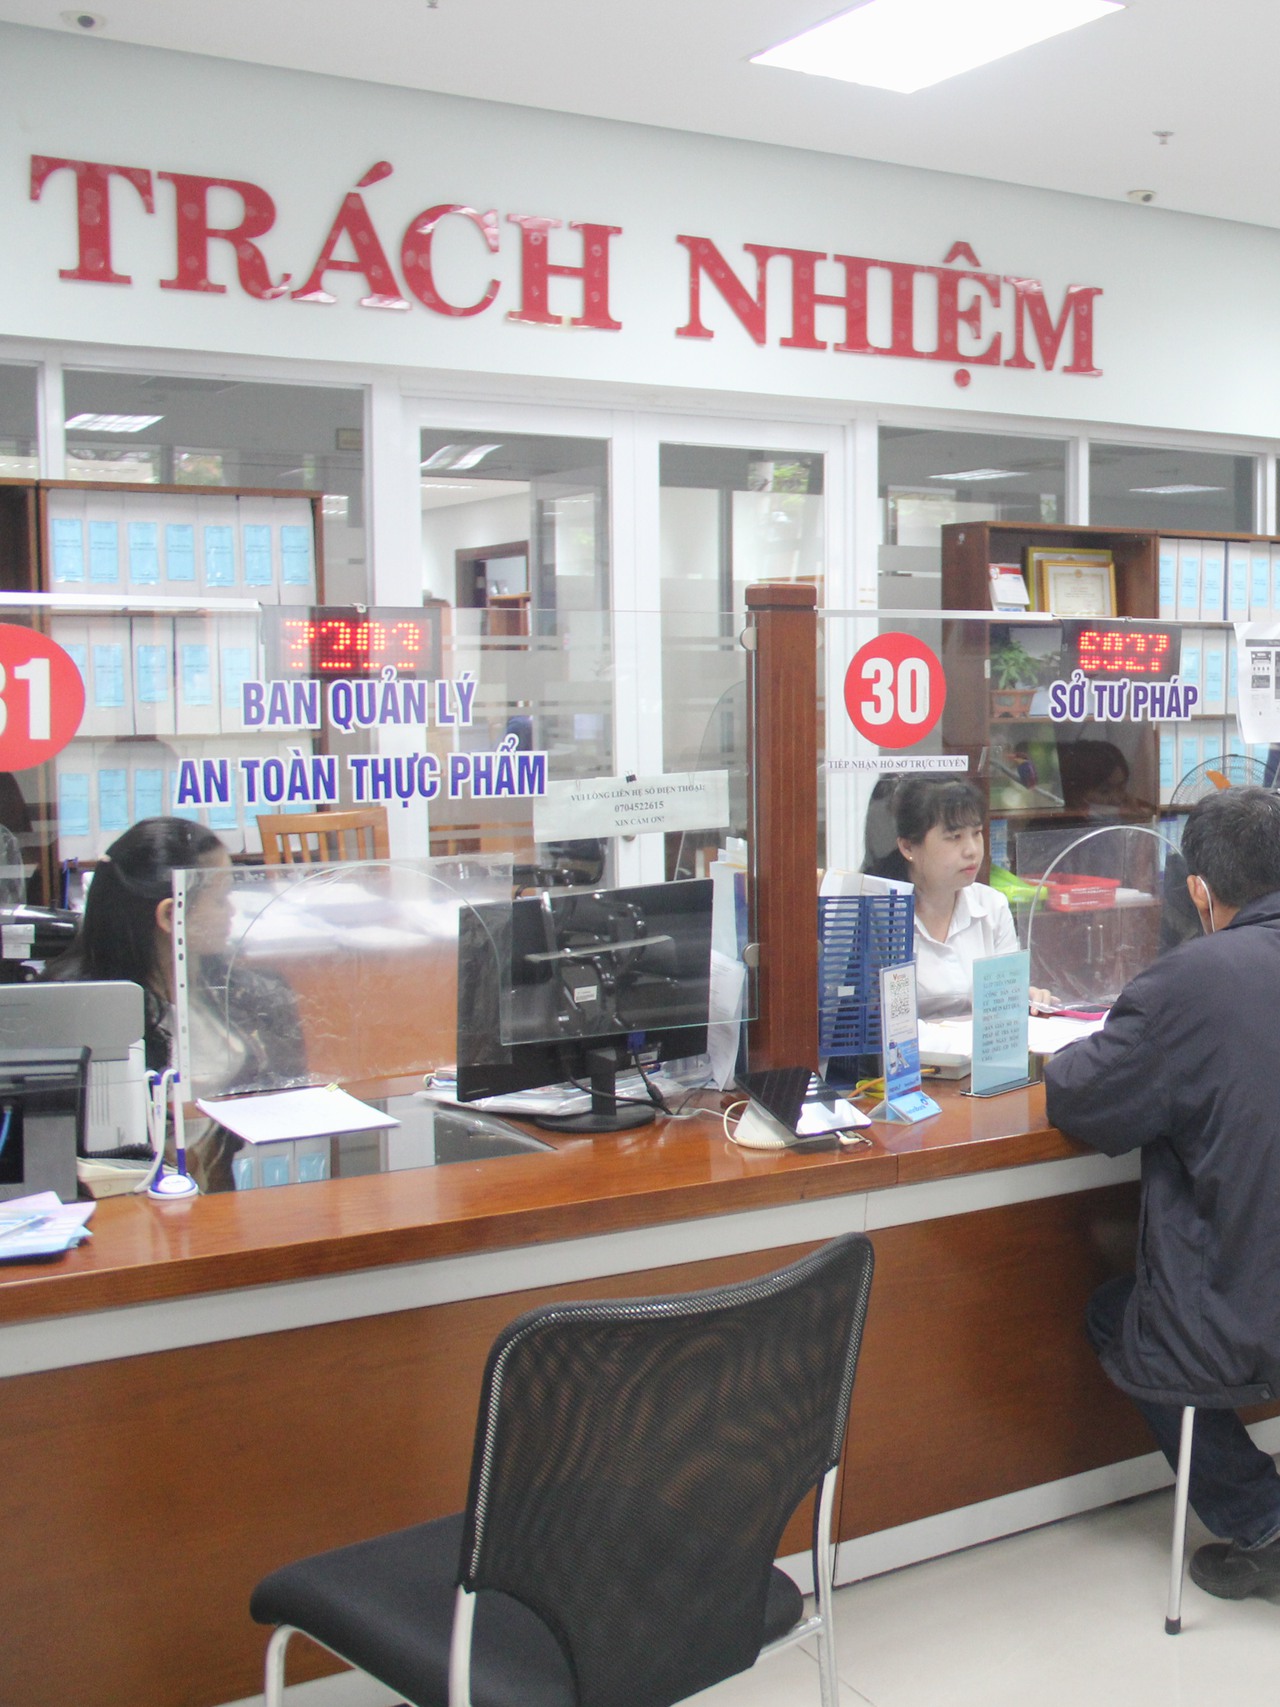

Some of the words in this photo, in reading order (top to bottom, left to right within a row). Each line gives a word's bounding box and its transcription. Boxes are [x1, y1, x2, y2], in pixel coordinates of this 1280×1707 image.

[30, 154, 623, 331] TRÁCH
[676, 234, 1104, 388] NHIỆM
[0, 657, 51, 740] 1
[242, 681, 319, 727] BAN
[331, 669, 427, 730] QUẢN
[438, 673, 476, 725] LÝ
[859, 656, 931, 726] 30
[1050, 672, 1087, 719] SỞ
[1093, 680, 1128, 719] TƯ
[1133, 678, 1199, 719] PHÁP
[177, 759, 230, 805] AN
[241, 748, 337, 803] TOÀN
[350, 753, 440, 808] THỰC
[450, 735, 547, 797] PHẨM
[571, 793, 587, 801] VUI
[586, 790, 610, 801] LÒNG
[611, 788, 630, 798] LIÊN
[631, 787, 643, 798] HỆ
[656, 785, 676, 797] ĐIỆN
[828, 758, 849, 769] TIẾP
[850, 759, 878, 770] NHẬN
[880, 758, 894, 769] HỒ
[895, 758, 908, 768] SƠ
[909, 758, 935, 770] TRỰC
[937, 758, 967, 768] TUYẾN
[614, 800, 665, 813] 0704522615
